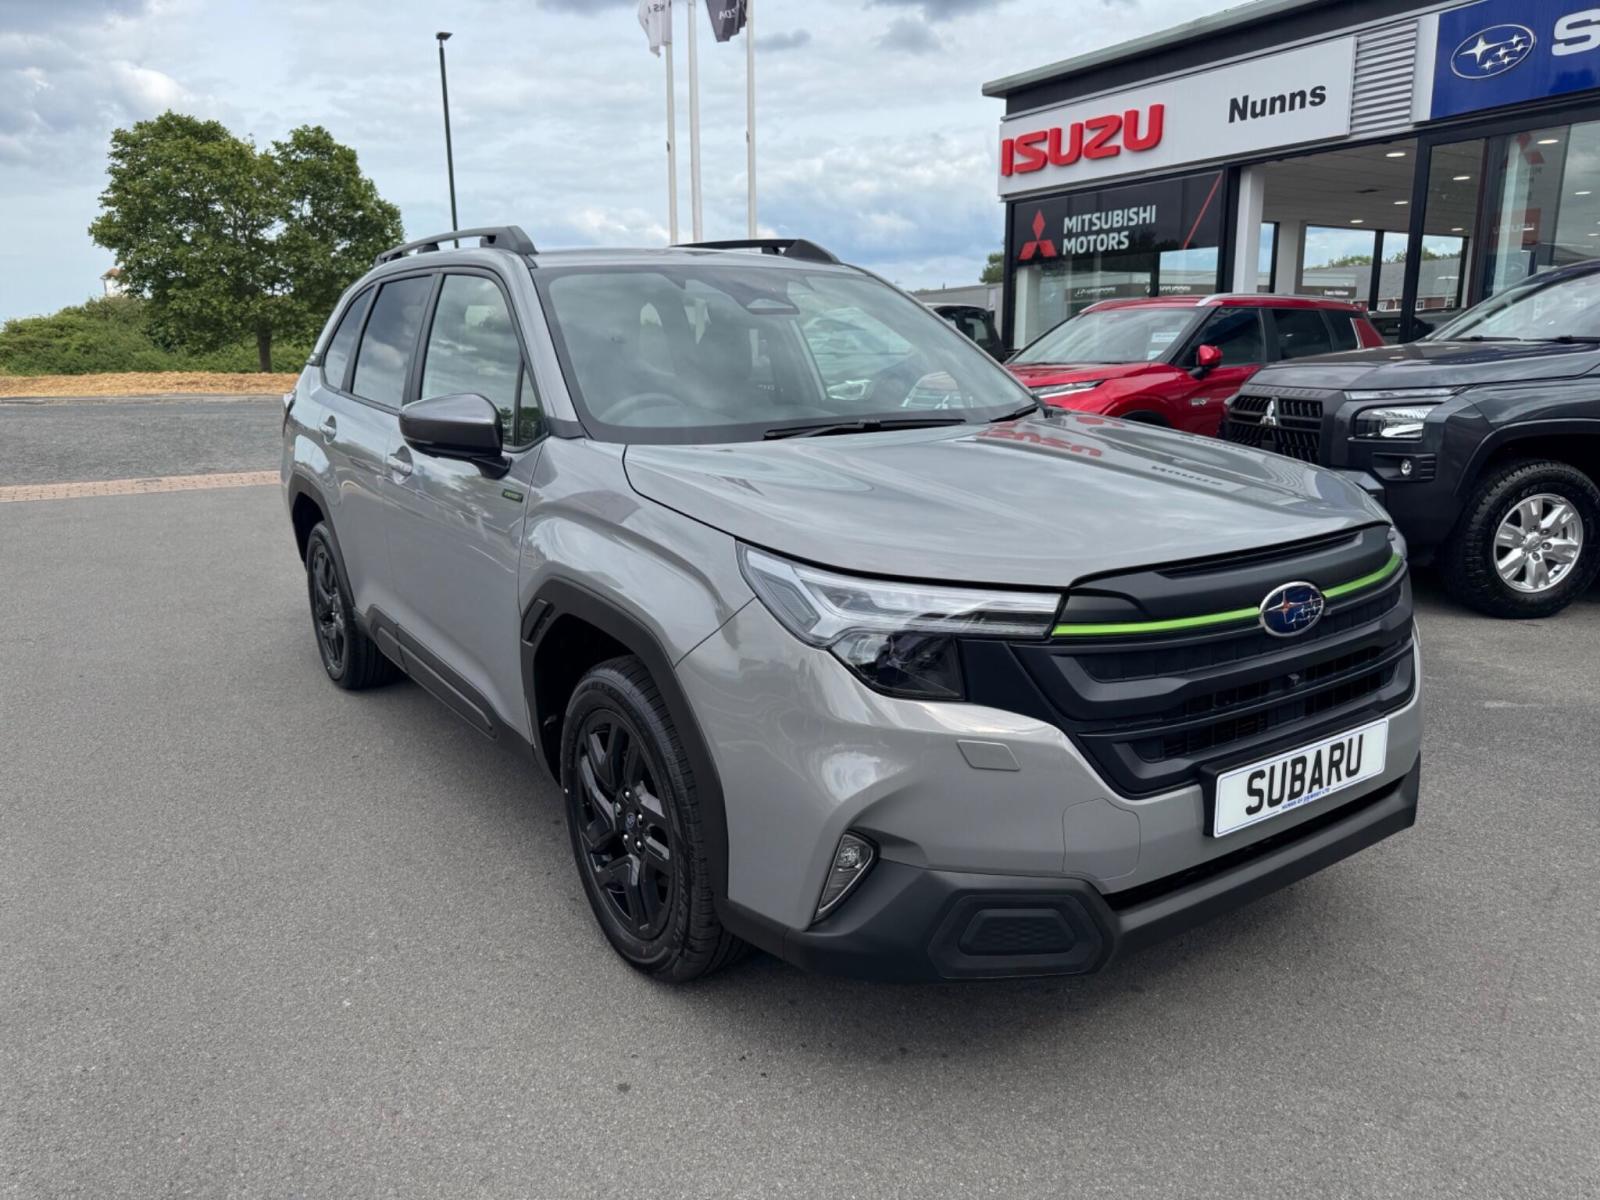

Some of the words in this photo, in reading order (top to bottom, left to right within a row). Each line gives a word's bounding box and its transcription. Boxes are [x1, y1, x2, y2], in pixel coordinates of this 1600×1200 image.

[1228, 85, 1326, 123] Nunns
[1001, 104, 1164, 177] ISUZU
[1063, 205, 1156, 234] MITSUBISHI
[1062, 231, 1129, 255] MOTORS
[1245, 734, 1364, 816] SUBARU
